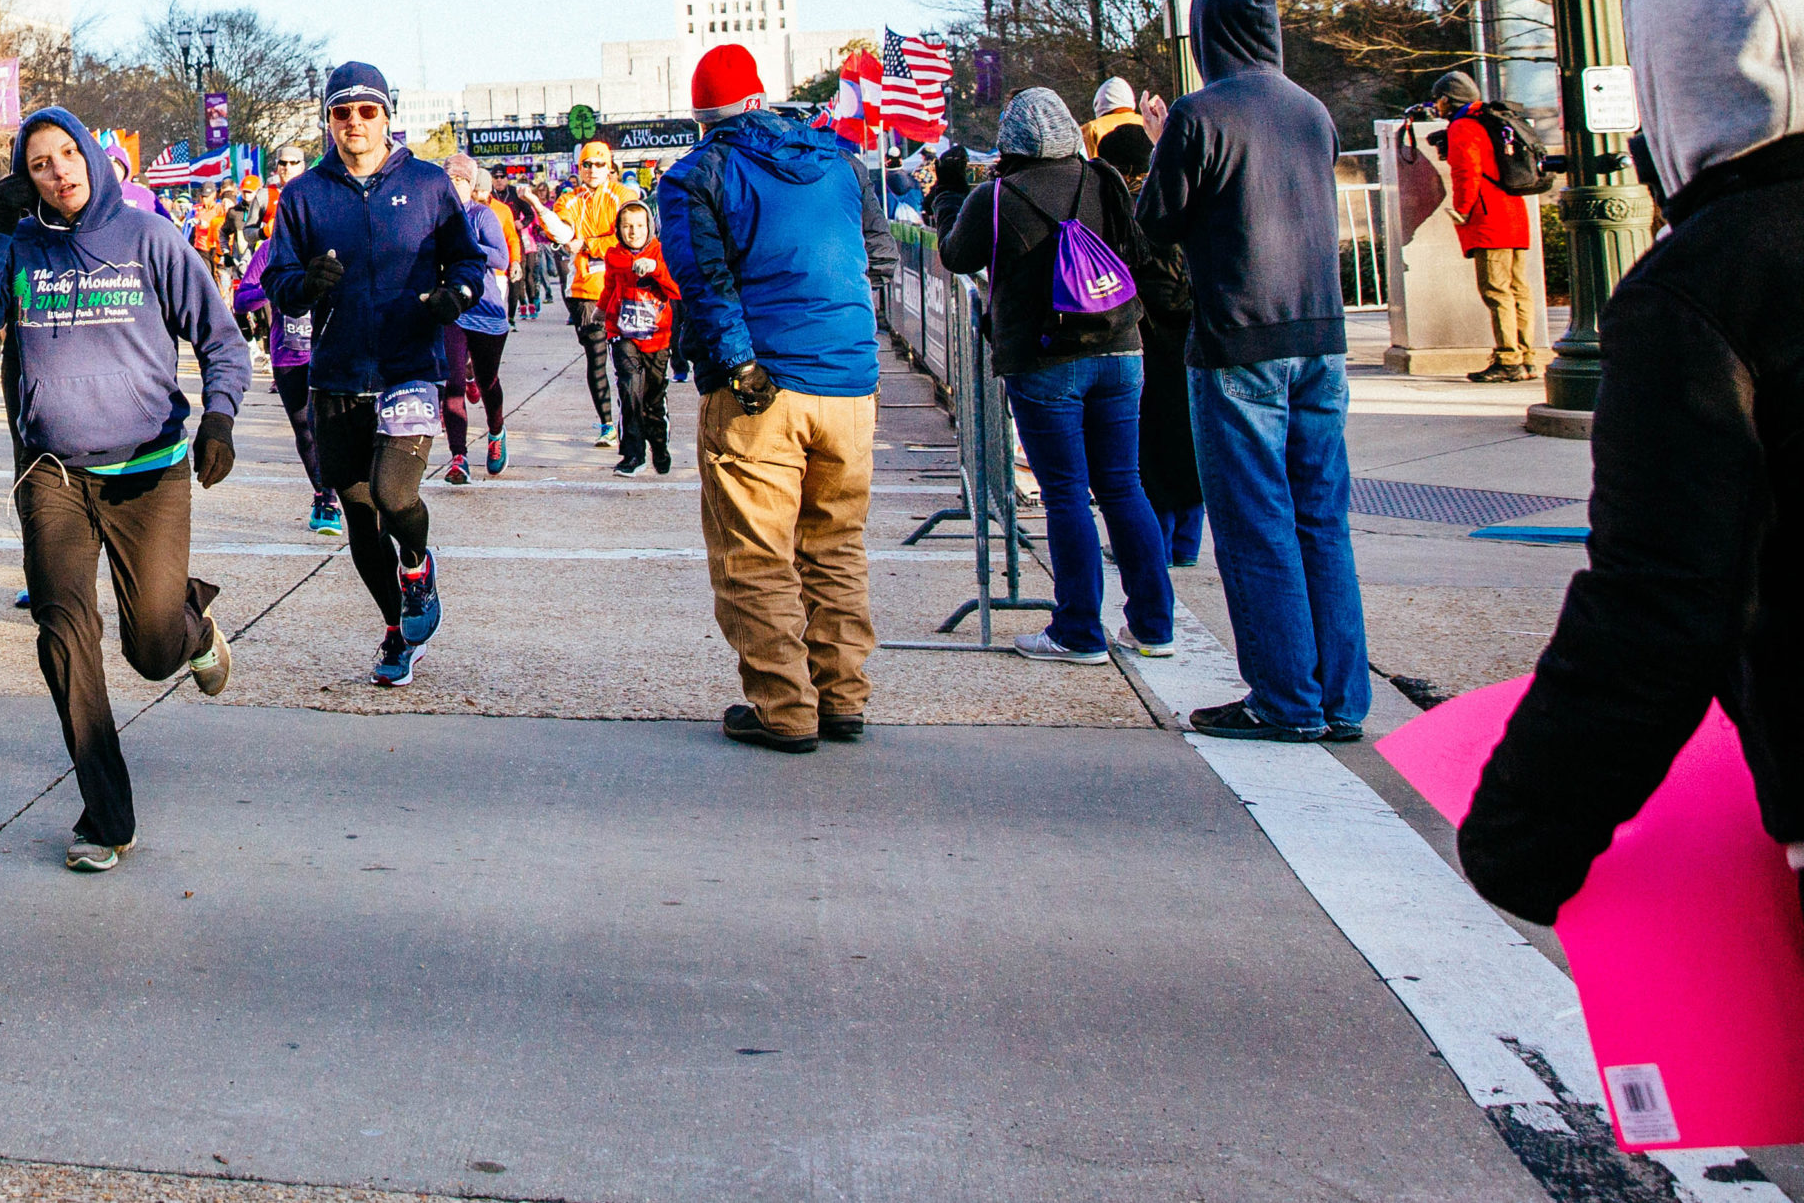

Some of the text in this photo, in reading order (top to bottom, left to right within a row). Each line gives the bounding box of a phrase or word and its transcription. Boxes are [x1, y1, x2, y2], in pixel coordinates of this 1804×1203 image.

[472, 129, 544, 144] LOUISIANA
[631, 128, 652, 137] THE
[620, 133, 695, 147] ADVOCATE
[473, 143, 519, 154] QUARTER
[531, 142, 545, 152] 5K
[34, 269, 54, 281] The
[36, 274, 141, 294] Rocky Mountain
[1085, 271, 1118, 294] LSU
[87, 291, 145, 308] HOSTEL
[76, 308, 94, 318] Park
